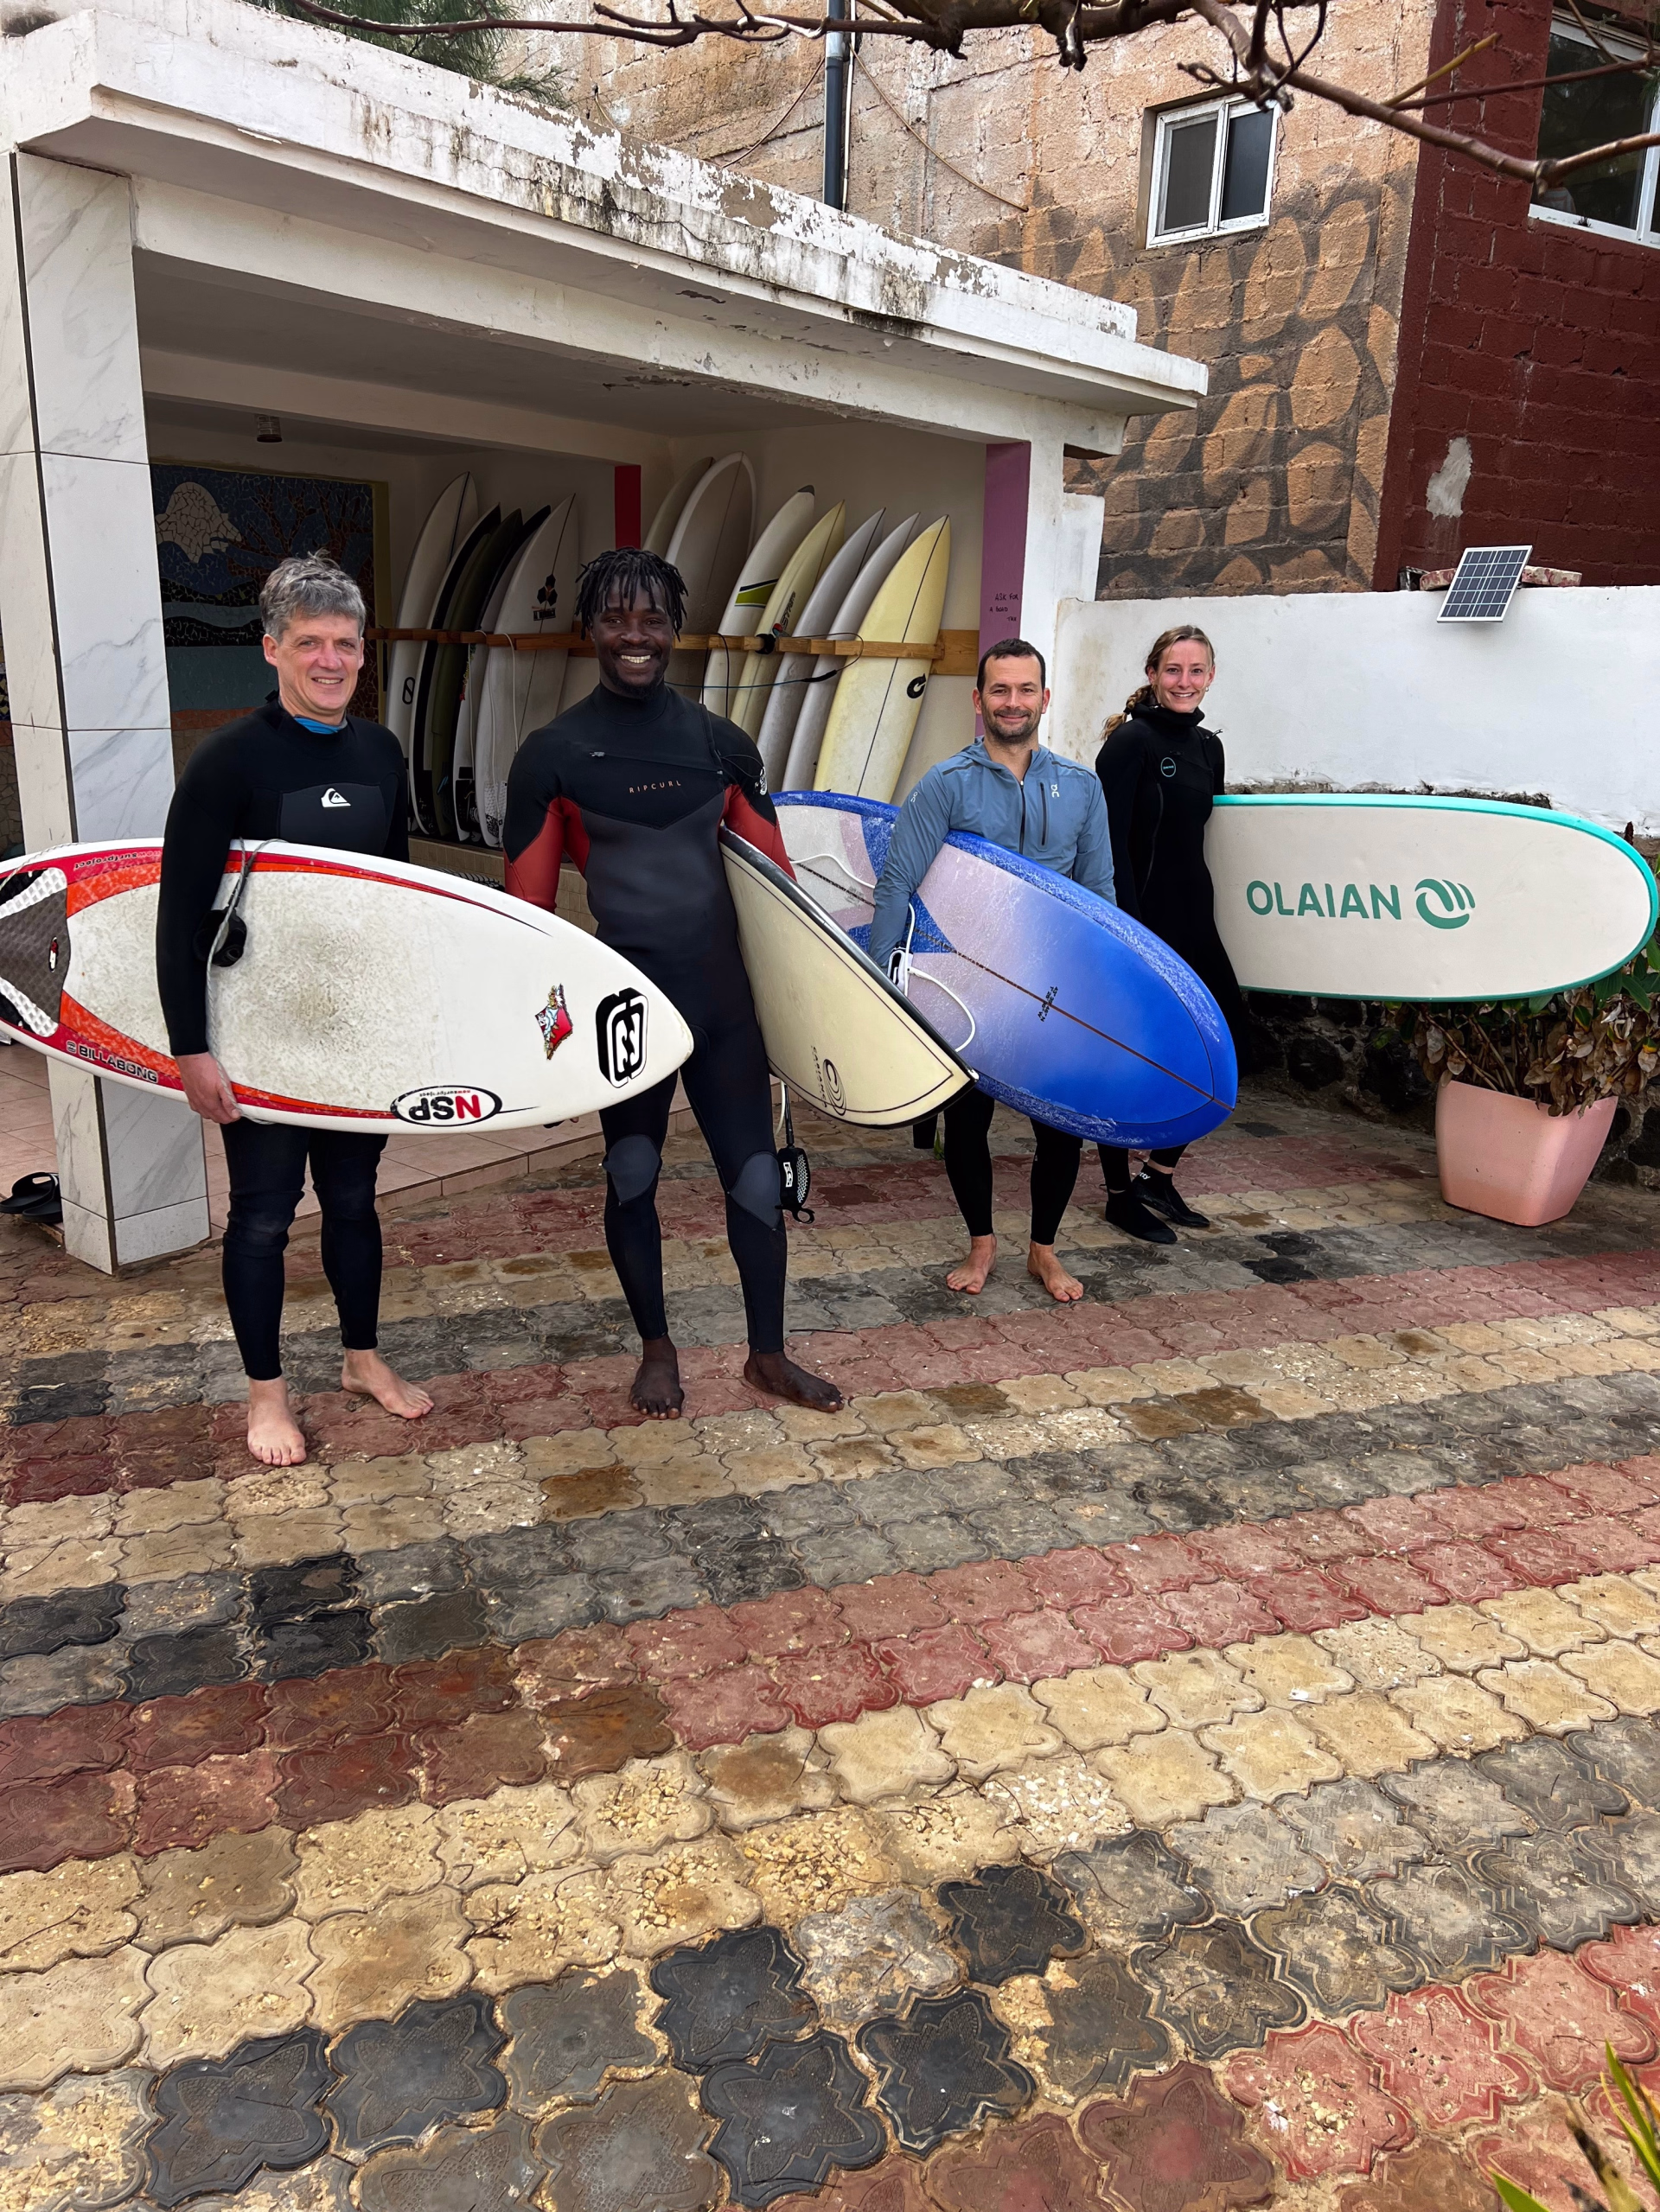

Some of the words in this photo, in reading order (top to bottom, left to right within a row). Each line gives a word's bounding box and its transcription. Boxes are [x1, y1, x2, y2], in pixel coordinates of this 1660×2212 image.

[1009, 592, 1018, 601] FOR
[629, 780, 681, 794] RIPCURL
[1246, 879, 1402, 921] OLAIAN
[79, 1044, 157, 1084] BILLABONG
[408, 1093, 482, 1121] NSP
